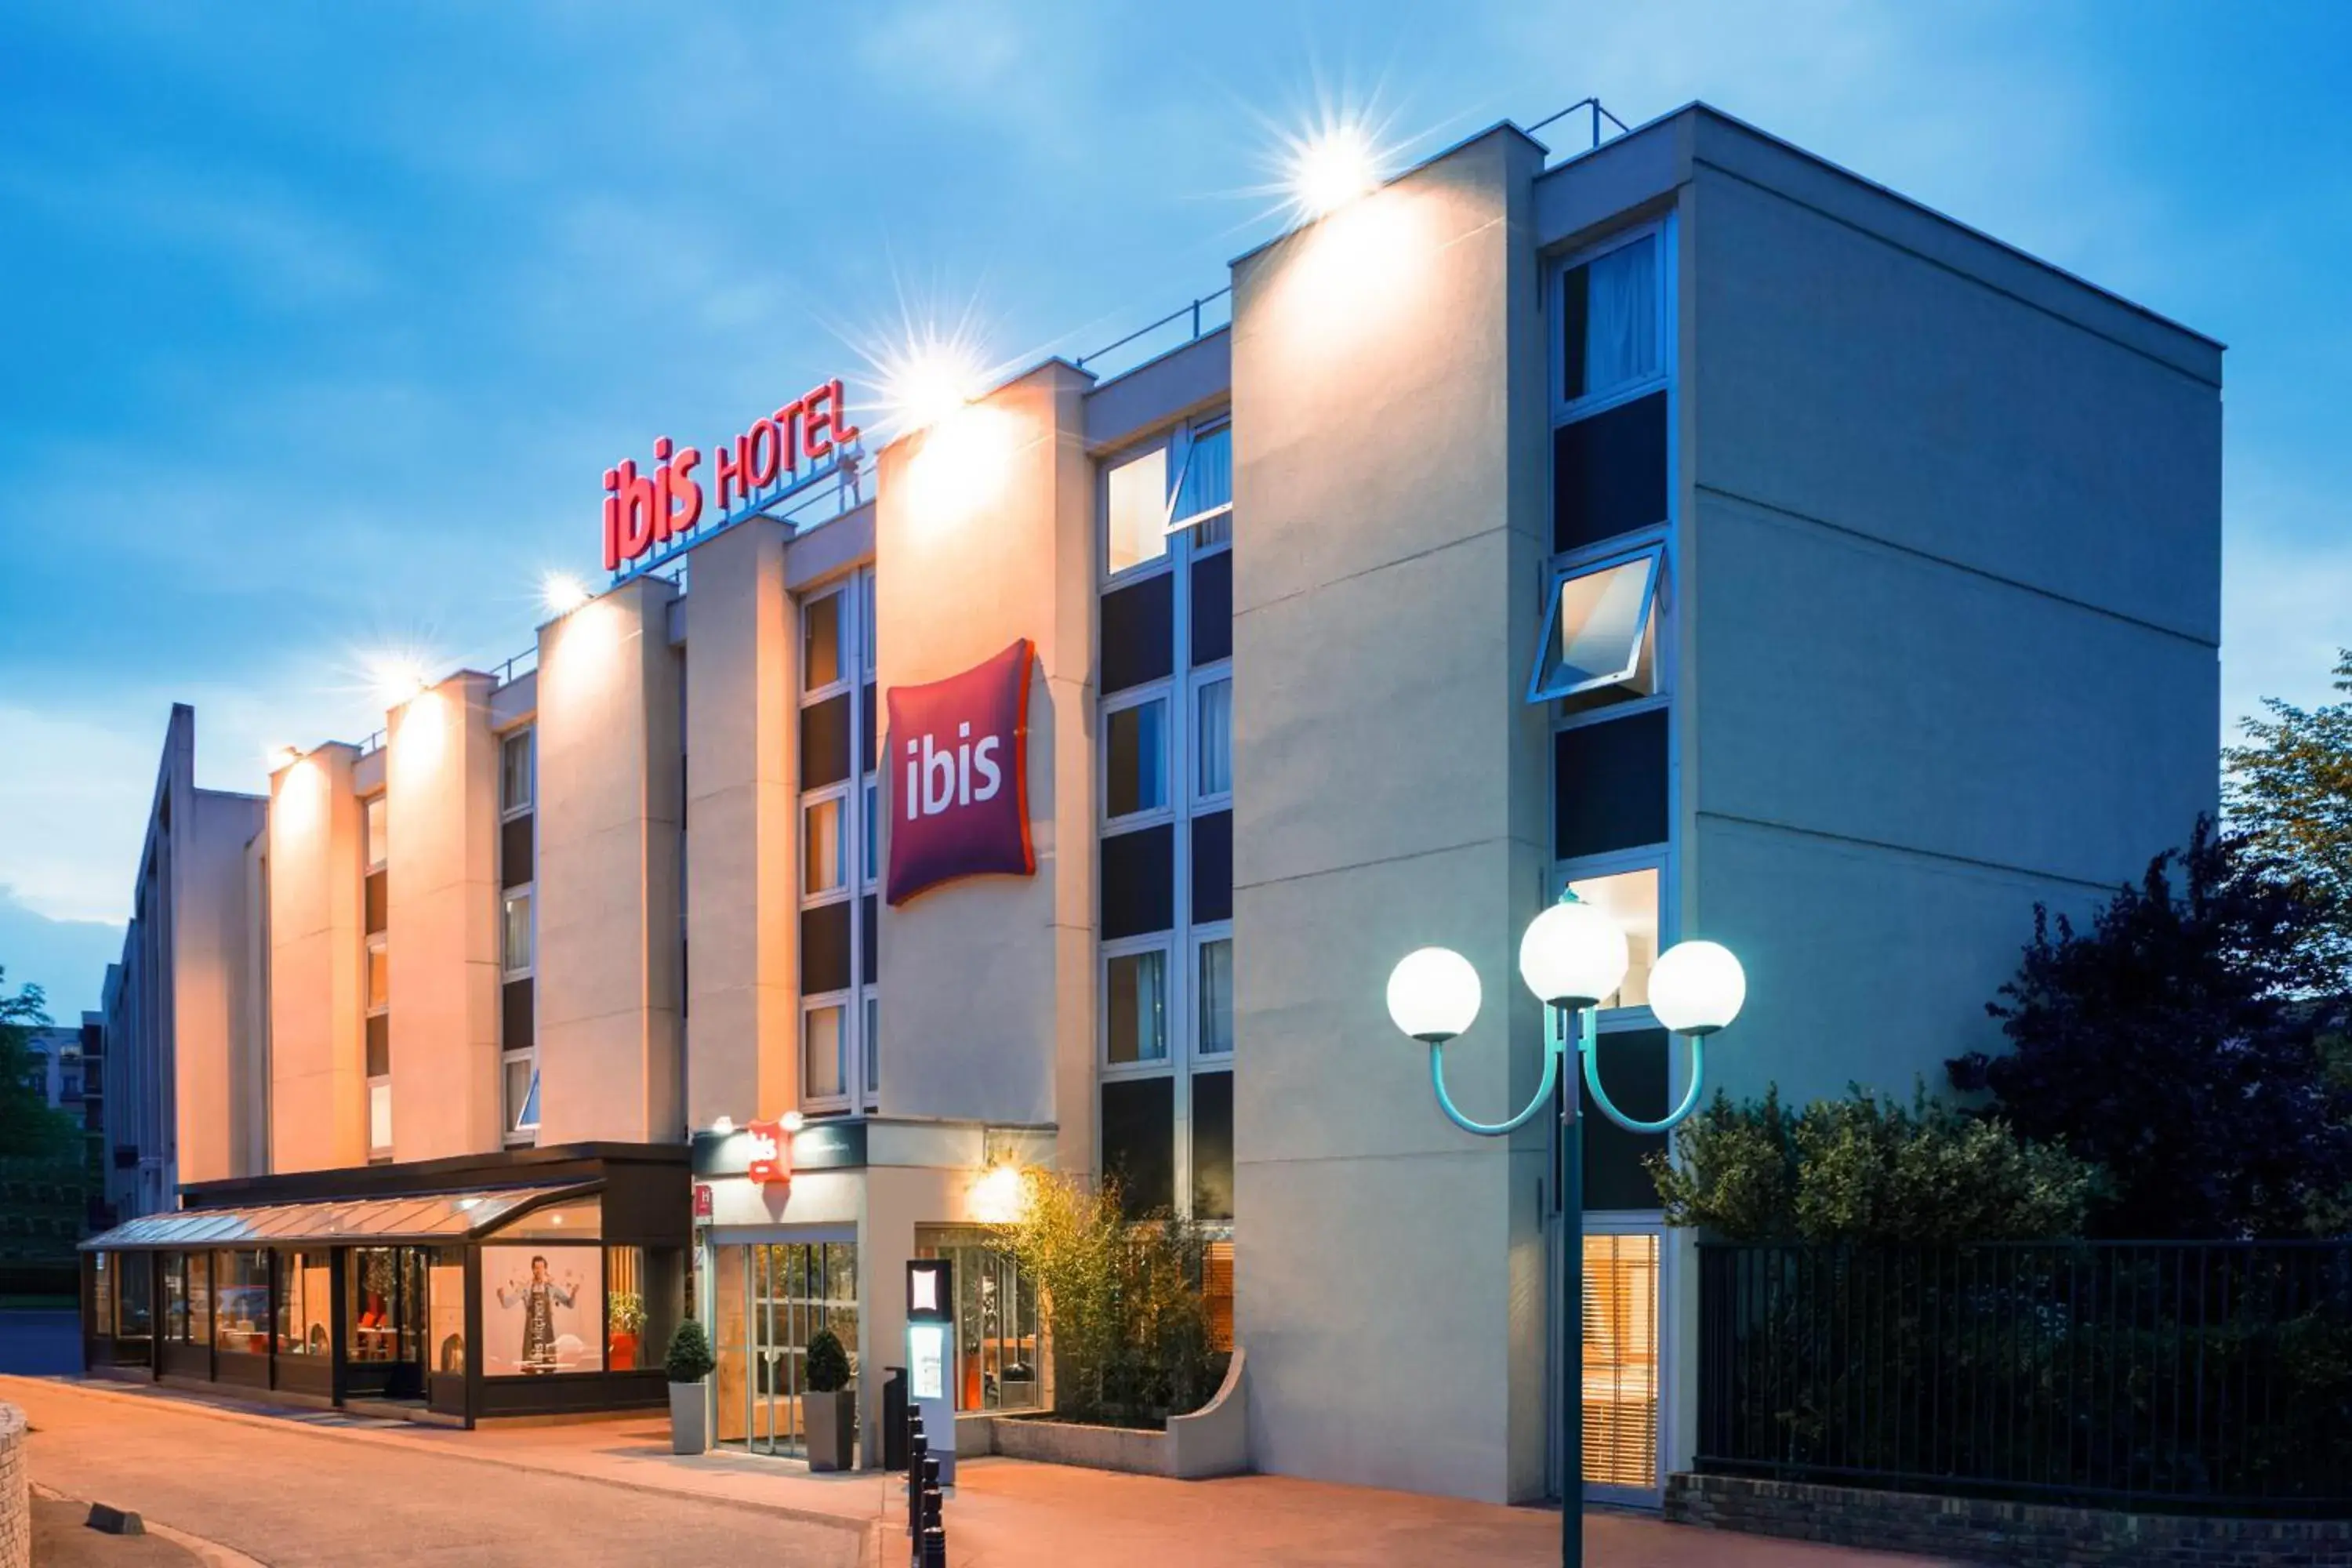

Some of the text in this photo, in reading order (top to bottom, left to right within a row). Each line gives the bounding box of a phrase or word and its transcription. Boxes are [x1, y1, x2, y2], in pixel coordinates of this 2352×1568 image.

[603, 377, 860, 571] ibis HOTEL
[907, 721, 1001, 821] ibis
